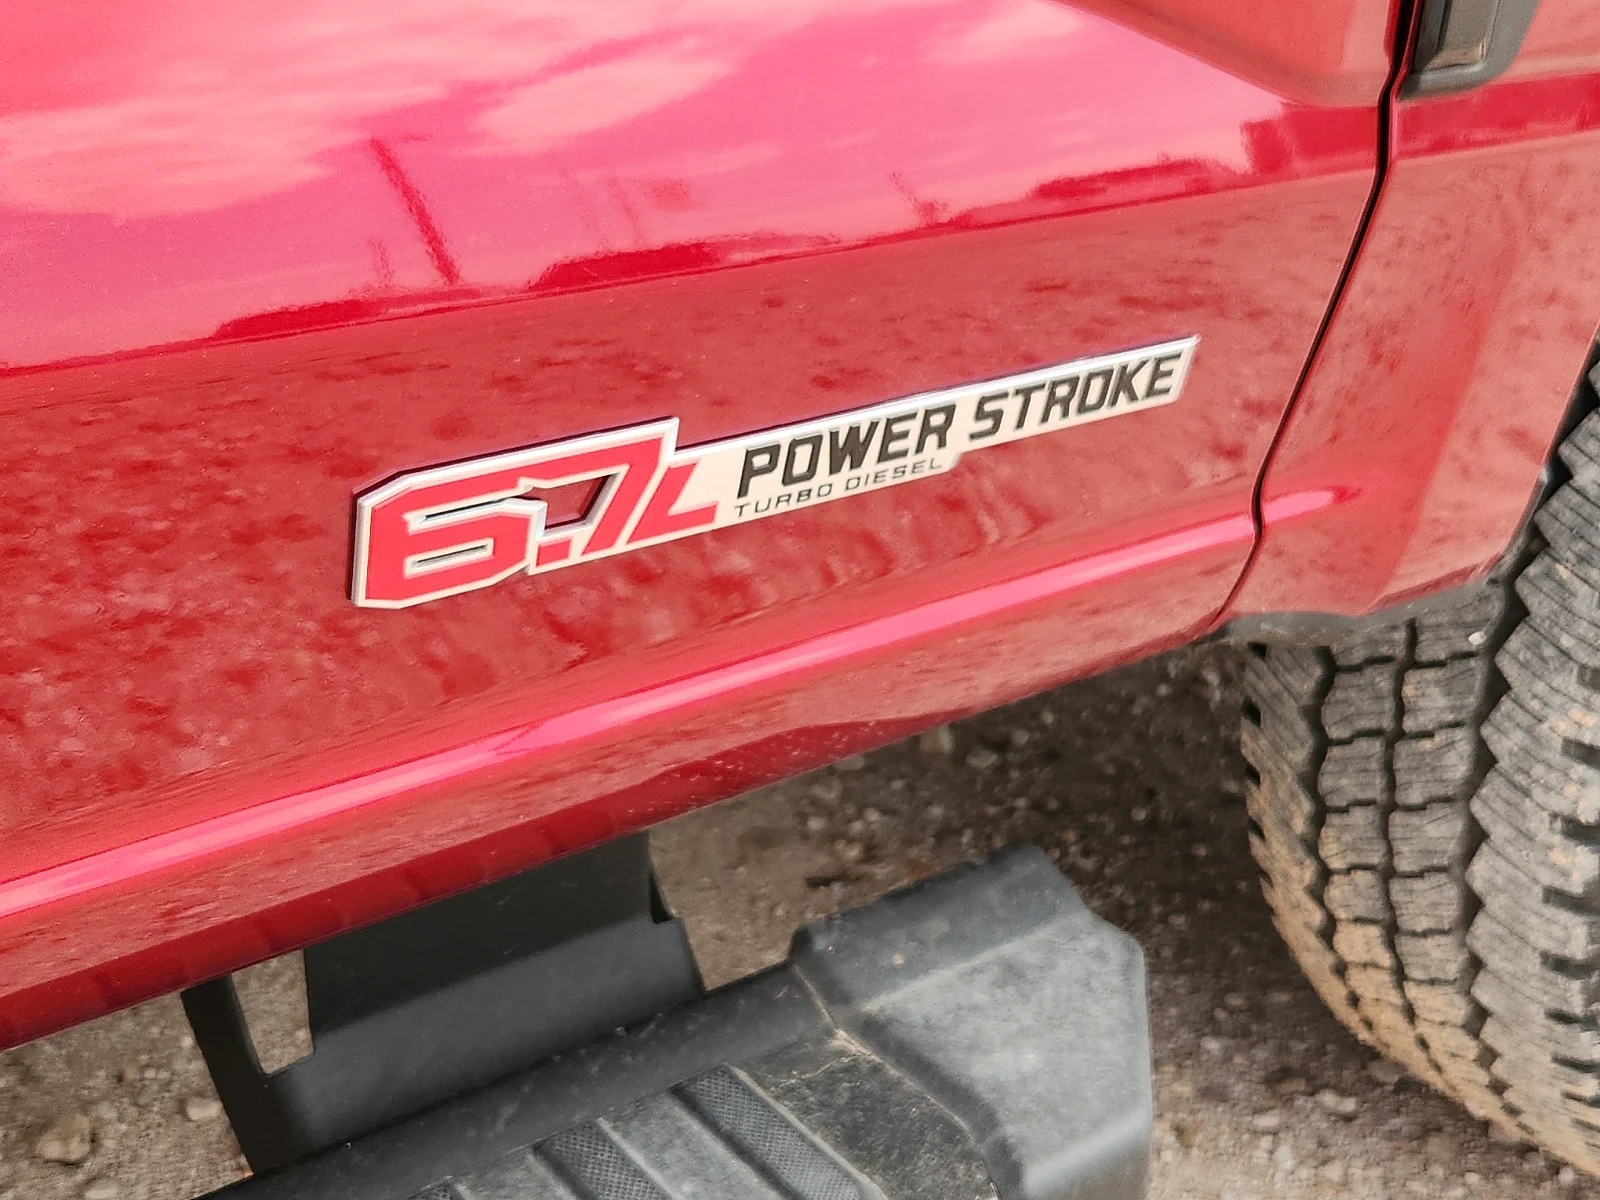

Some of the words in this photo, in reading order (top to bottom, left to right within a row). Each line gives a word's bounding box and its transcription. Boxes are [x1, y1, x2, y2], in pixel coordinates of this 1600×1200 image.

[364, 432, 718, 601] 6.7L
[736, 399, 957, 499] POWER
[968, 352, 1182, 442] STROKE
[734, 482, 833, 519] TURBO
[844, 457, 942, 492] DIESEL
